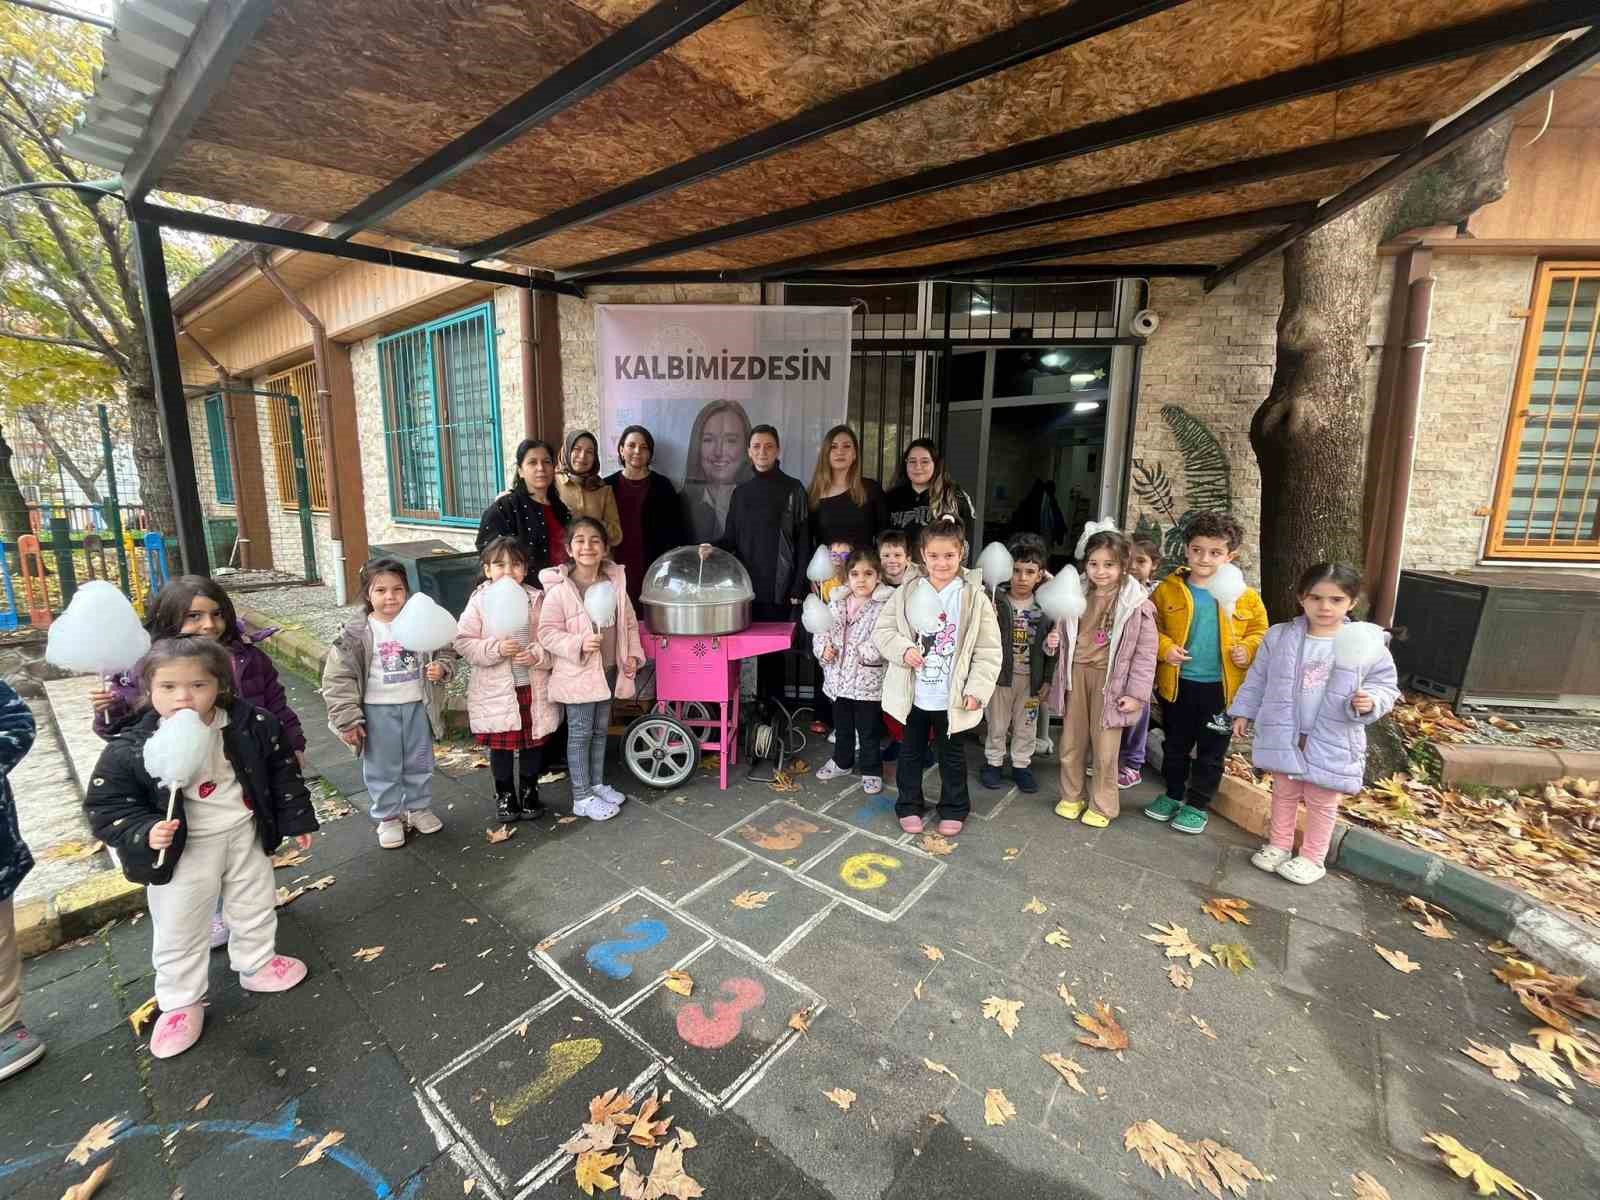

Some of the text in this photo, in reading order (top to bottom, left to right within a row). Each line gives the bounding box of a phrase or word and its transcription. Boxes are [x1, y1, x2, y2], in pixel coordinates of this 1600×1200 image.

[615, 348, 832, 381] KALBİMİZDESİN
[839, 851, 902, 891] 6
[585, 918, 669, 980] 2
[676, 977, 766, 1050] 3
[489, 1037, 604, 1128] 1
